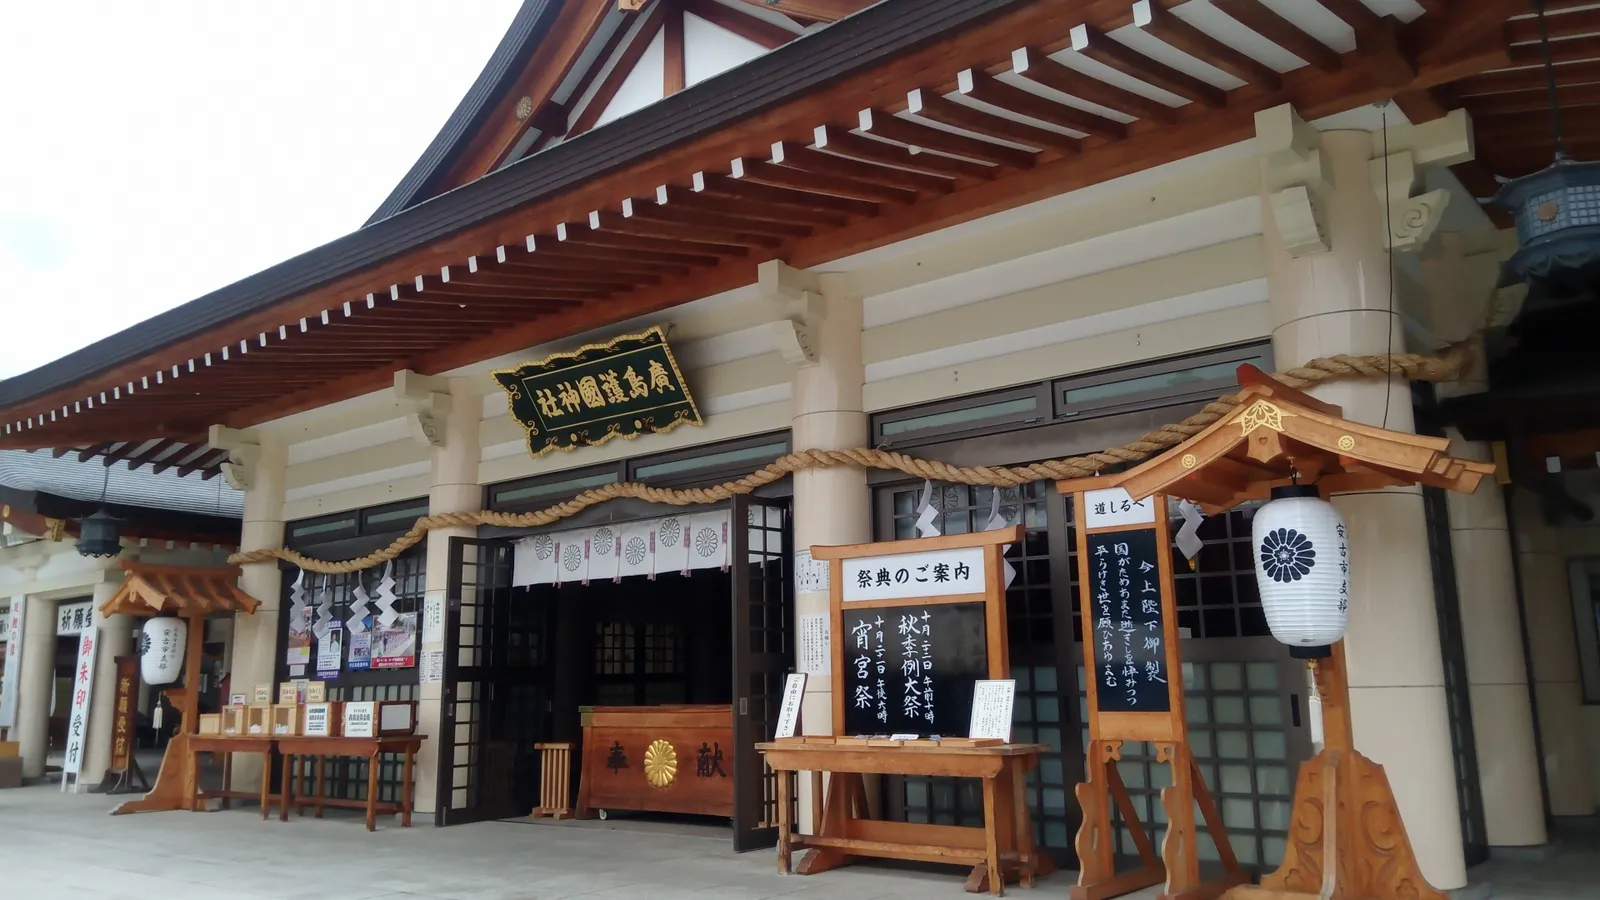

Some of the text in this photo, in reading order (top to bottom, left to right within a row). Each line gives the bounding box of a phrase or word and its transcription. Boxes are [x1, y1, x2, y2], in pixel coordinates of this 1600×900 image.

[857, 561, 970, 589] 祭典のご案内
[1138, 560, 1167, 684] 今上陛下御製
[68, 636, 93, 764] 御朱印受付
[781, 676, 800, 737] ご自由にお取り下さい
[851, 619, 873, 709] 宵宮祭
[898, 613, 922, 718] 秋季例大祭
